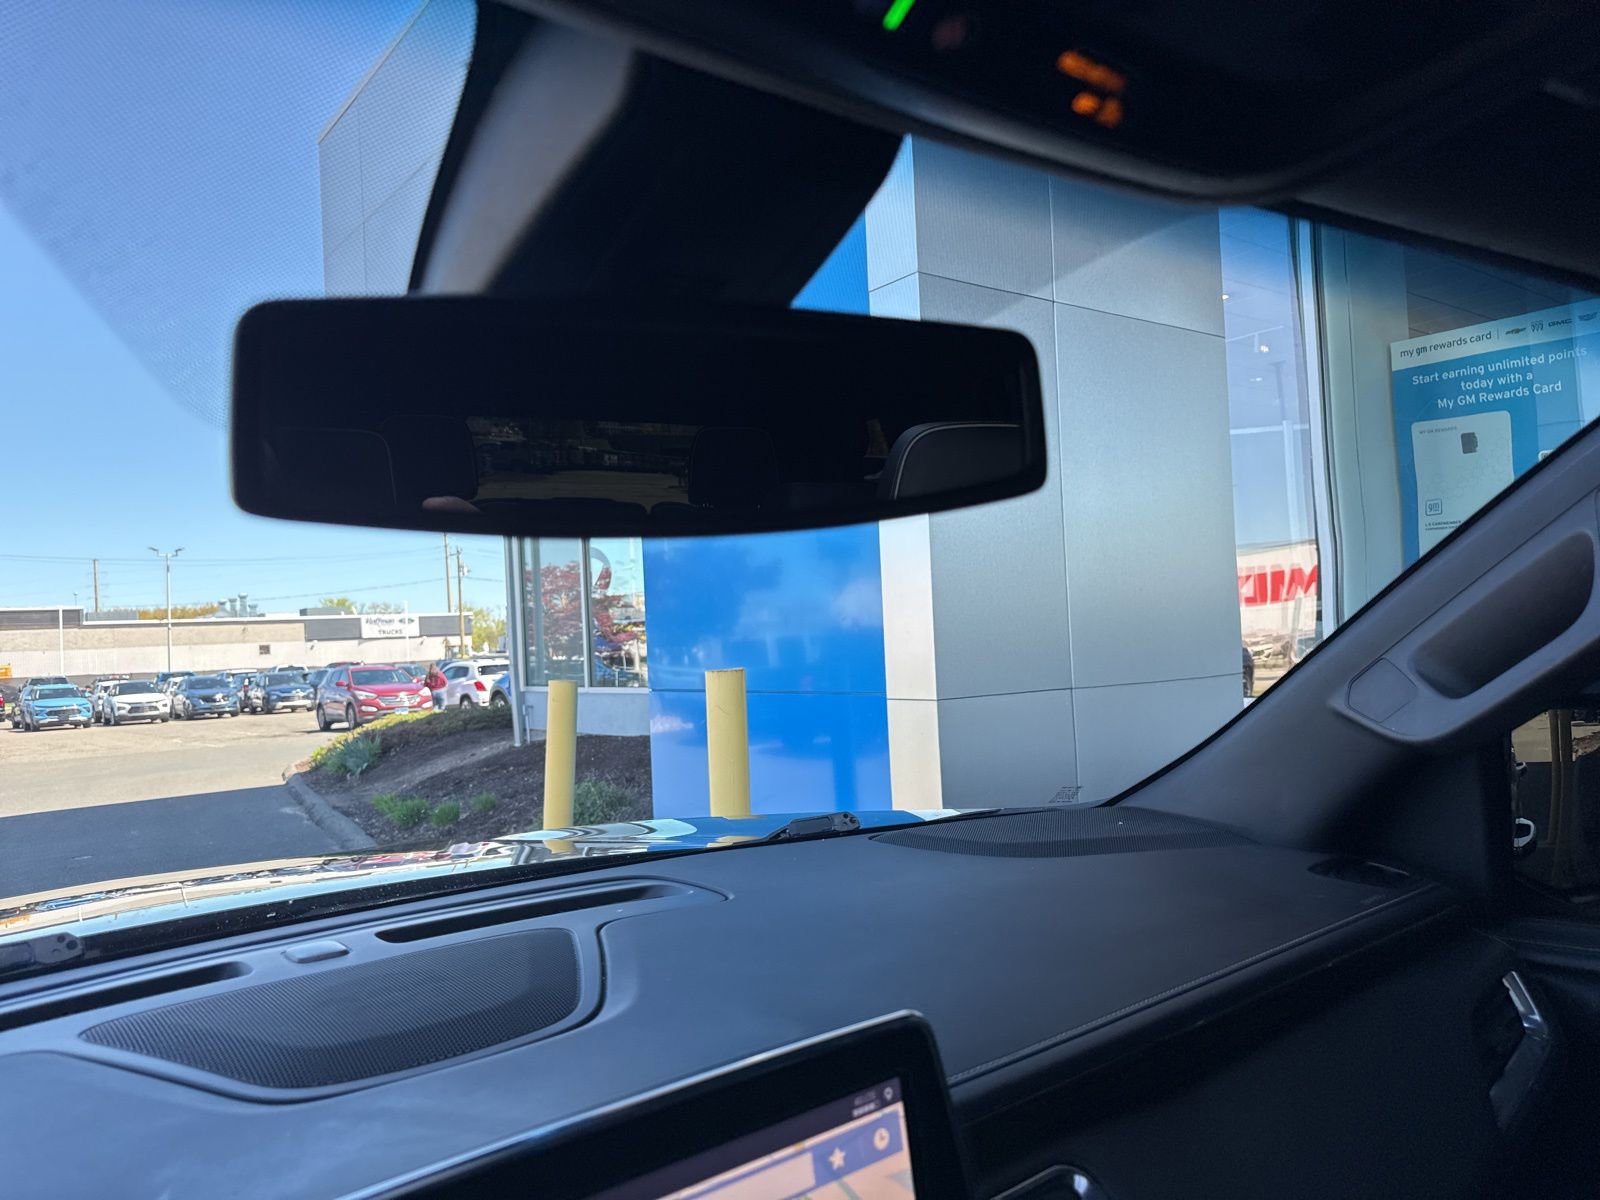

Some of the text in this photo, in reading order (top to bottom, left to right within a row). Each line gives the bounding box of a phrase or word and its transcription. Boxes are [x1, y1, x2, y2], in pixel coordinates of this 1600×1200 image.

[1548, 318, 1573, 327] GMC
[1400, 331, 1492, 358] my gm rewards card
[1412, 345, 1588, 385] Start earning unlimited points
[1437, 380, 1562, 409] My GM Rewards Card
[1460, 378, 1494, 391] today
[1497, 371, 1522, 385] with
